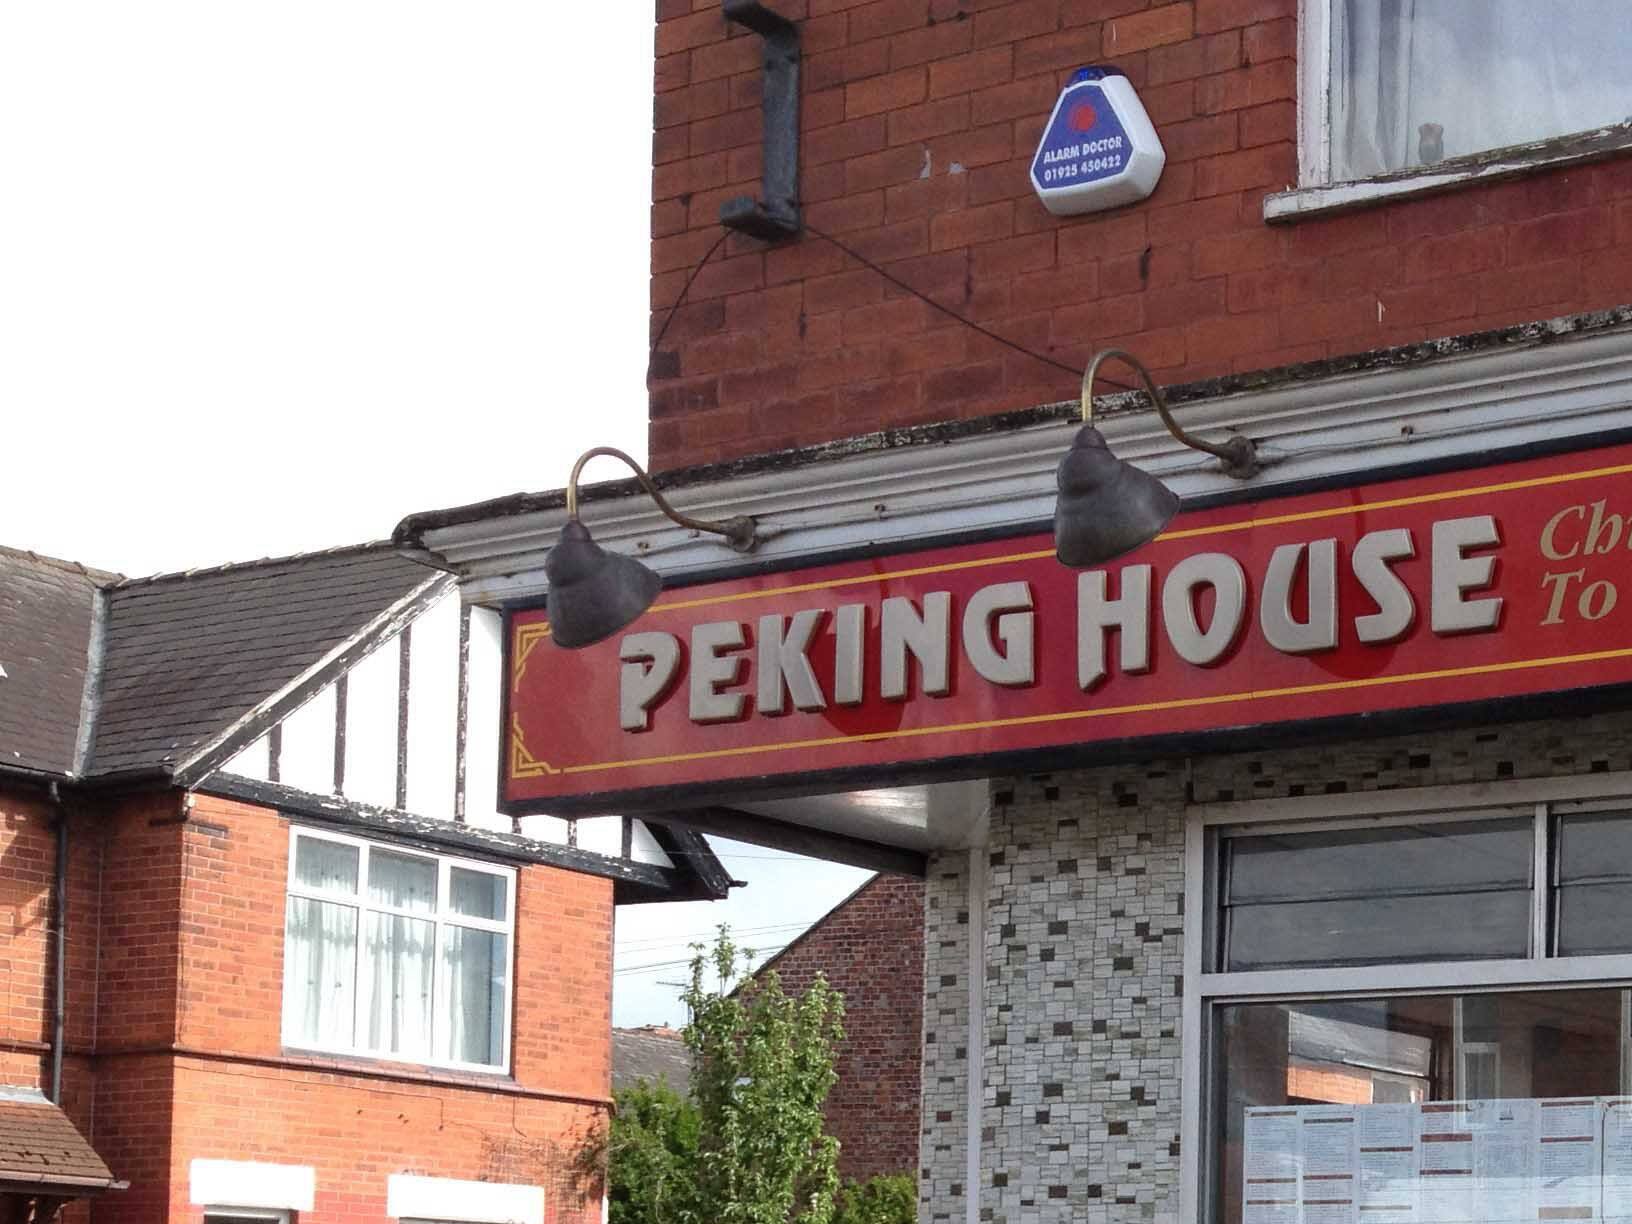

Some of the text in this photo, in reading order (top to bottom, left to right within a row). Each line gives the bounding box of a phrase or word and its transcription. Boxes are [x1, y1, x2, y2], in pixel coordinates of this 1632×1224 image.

[1043, 136, 1123, 163] ALARM DOCTOR
[1043, 154, 1121, 182] 01925 450422
[1539, 566, 1617, 625] To
[619, 514, 1503, 733] PEKING HOUSE
